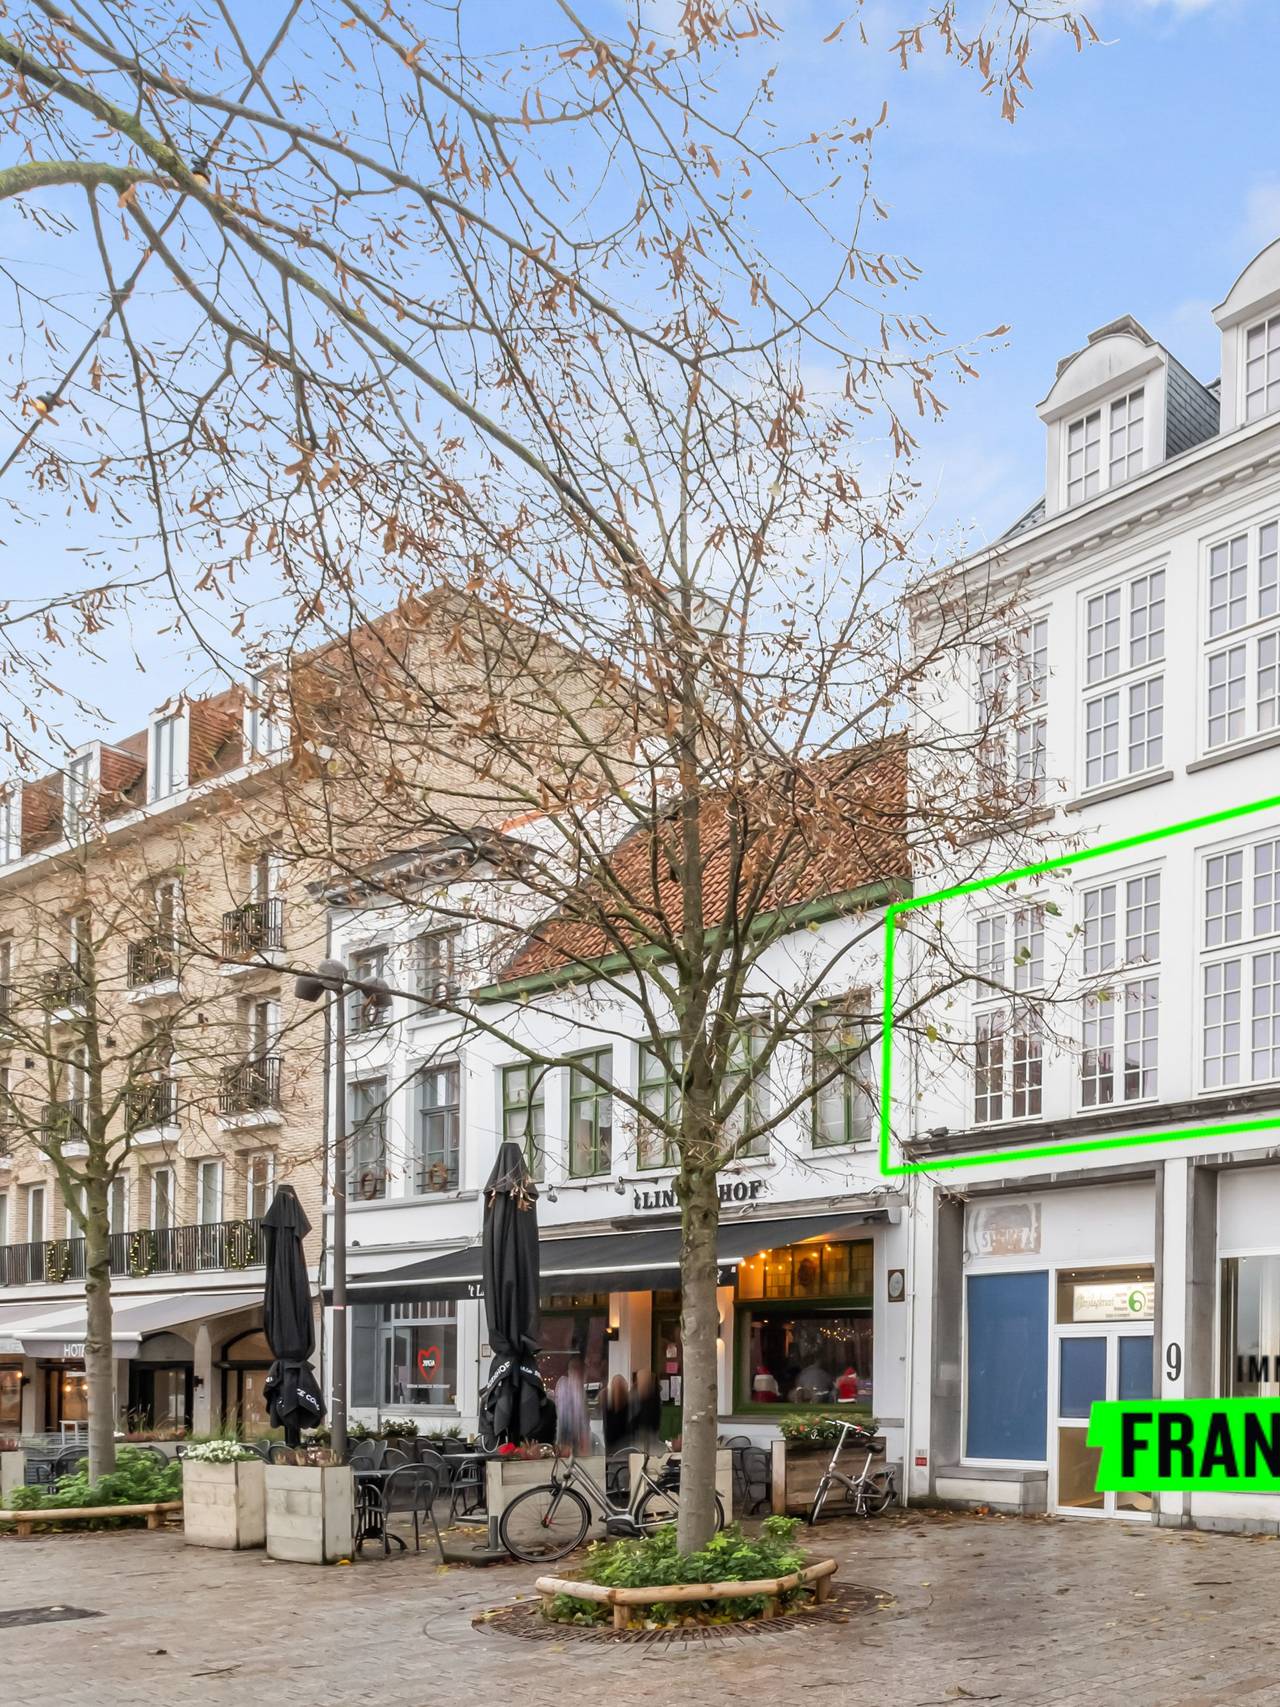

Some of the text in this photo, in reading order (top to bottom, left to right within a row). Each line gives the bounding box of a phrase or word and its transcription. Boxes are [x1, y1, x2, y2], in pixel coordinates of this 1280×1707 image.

[642, 1179, 762, 1209] LINHOF
[63, 1343, 86, 1357] HOT
[1166, 1342, 1182, 1382] 9
